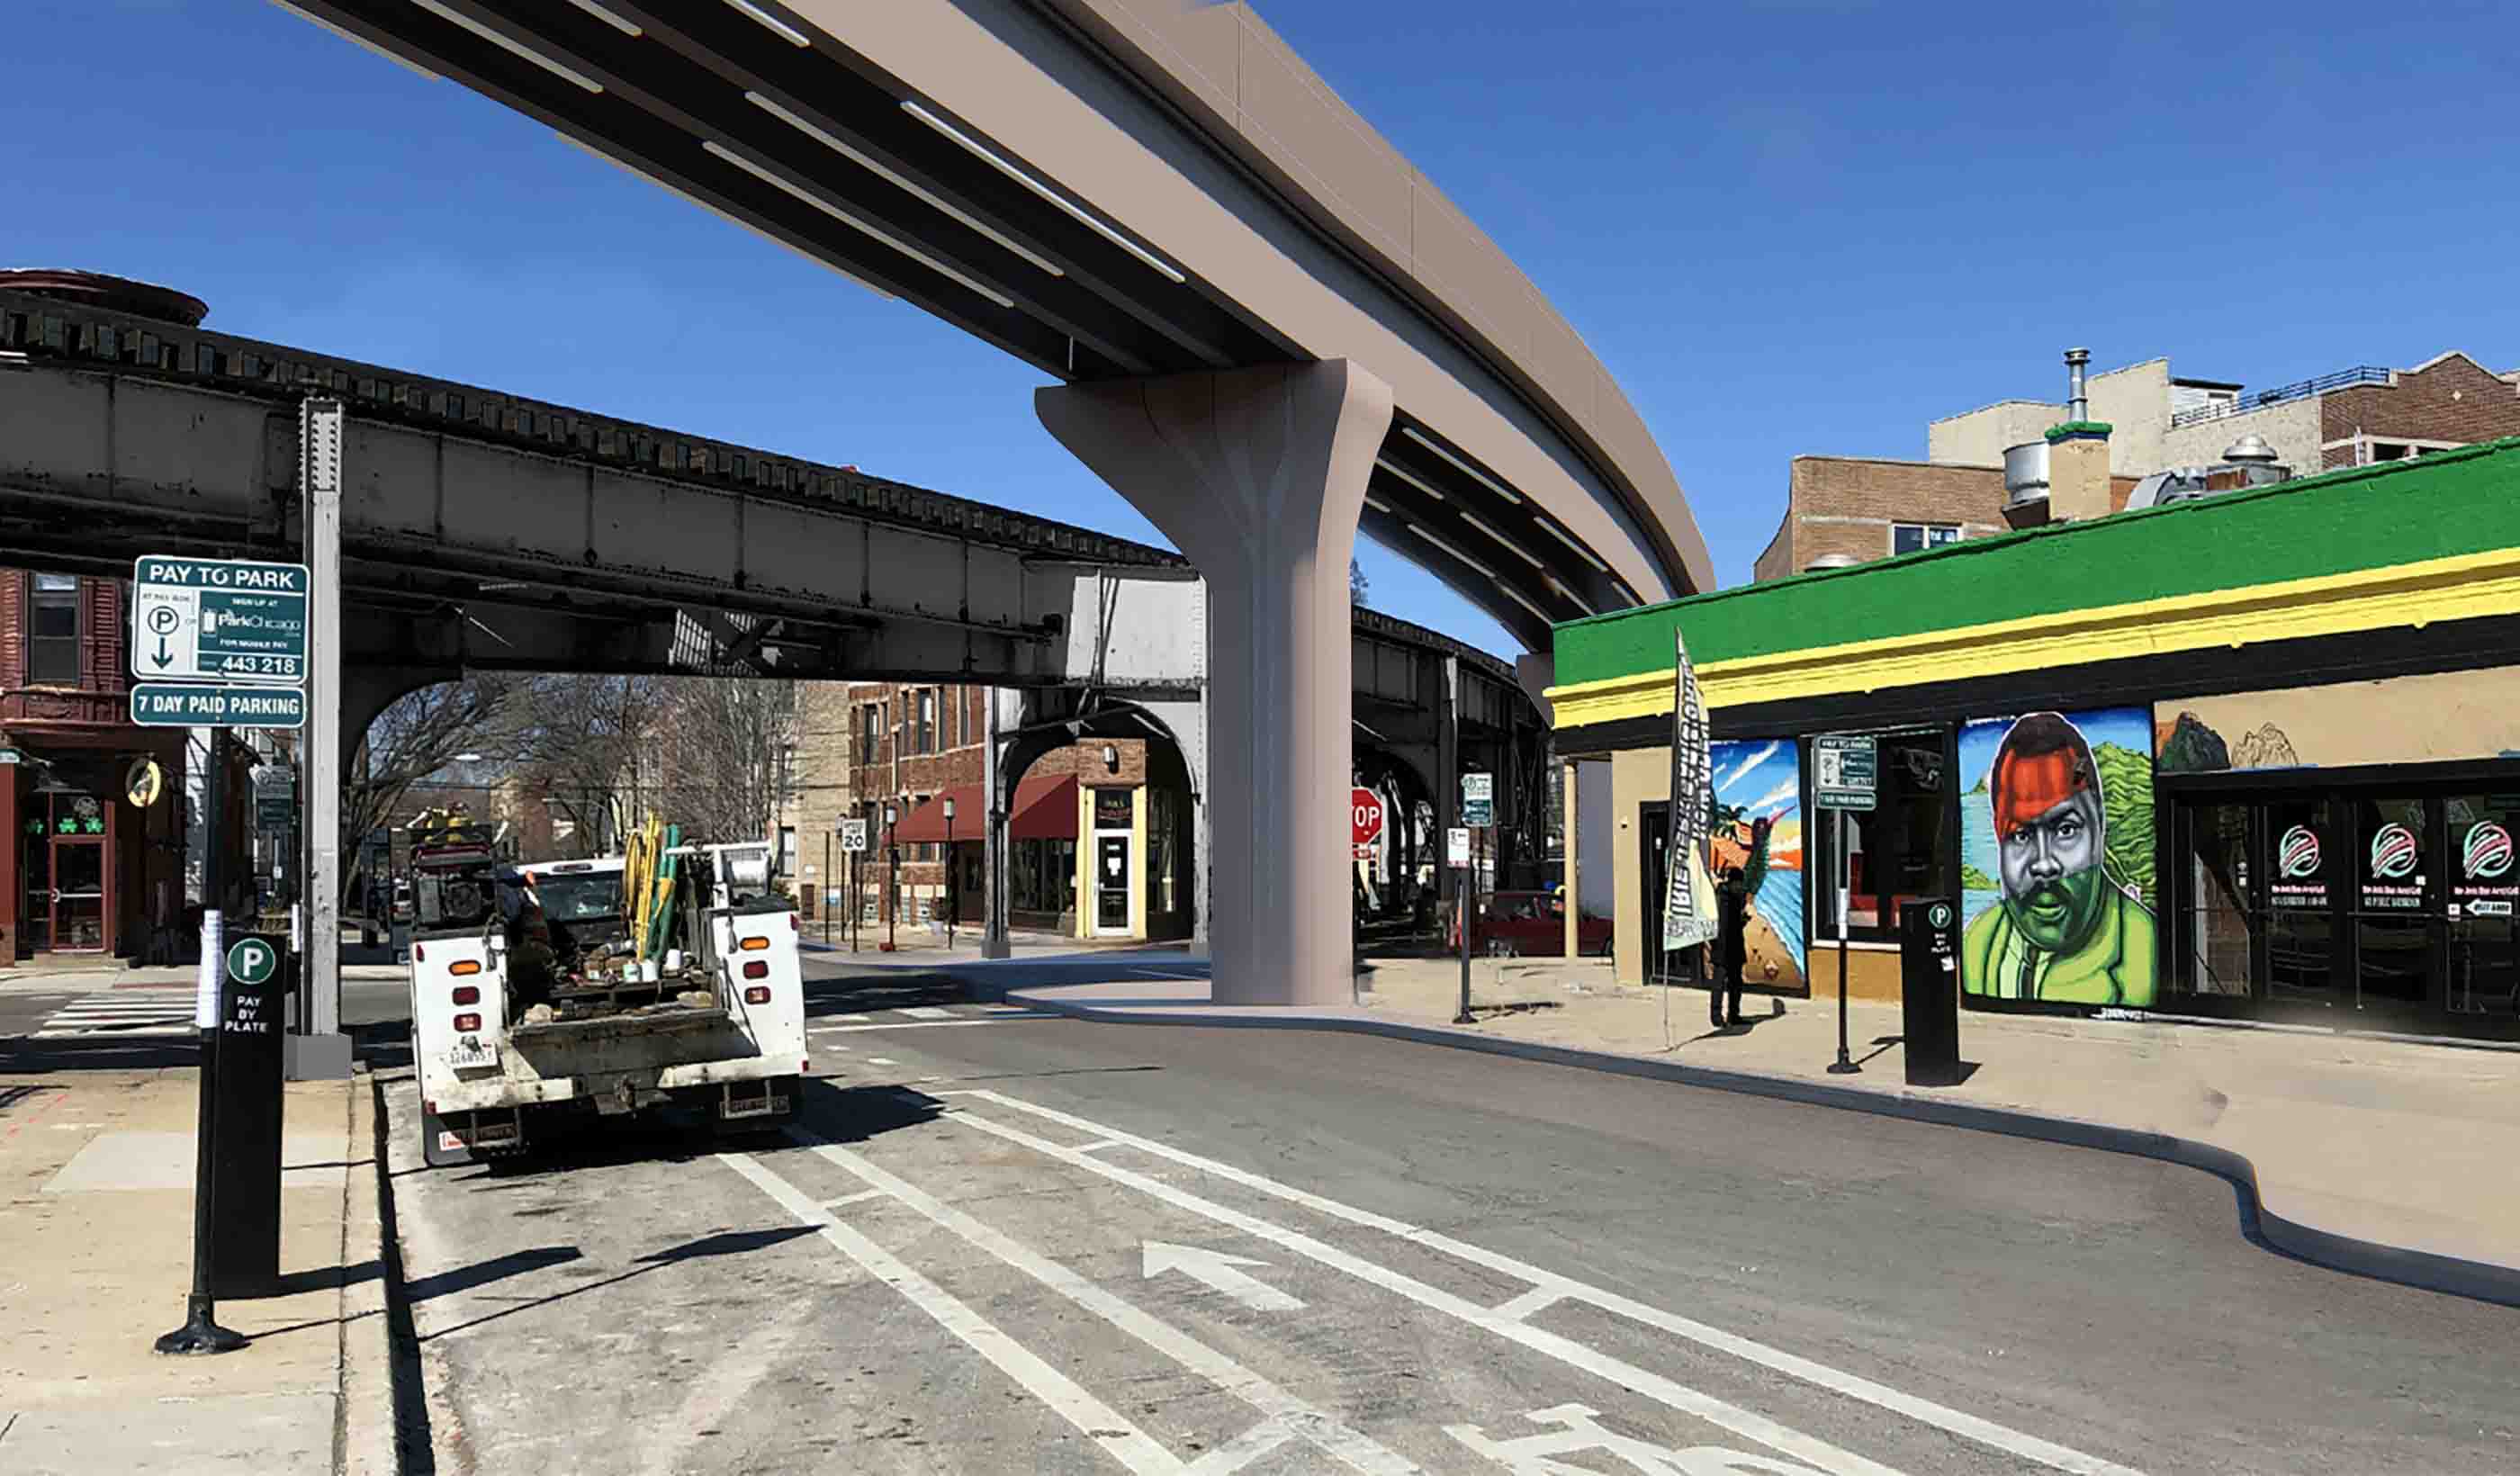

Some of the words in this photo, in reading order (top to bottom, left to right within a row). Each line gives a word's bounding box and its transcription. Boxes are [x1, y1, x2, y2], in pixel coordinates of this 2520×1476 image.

[149, 564, 192, 582] PAY
[198, 567, 229, 584] TO
[235, 570, 294, 589] PARK
[221, 656, 256, 672] 443
[261, 658, 296, 674] 218
[138, 696, 147, 712] 7
[153, 696, 184, 713] DAY
[189, 696, 225, 714] PAID
[230, 697, 300, 715] PARKING
[845, 835, 864, 848] 20
[1937, 907, 1947, 924] P
[243, 948, 264, 977] P
[237, 995, 262, 1007] PAY
[238, 1009, 257, 1020] BY
[225, 1021, 268, 1032] PLATE
